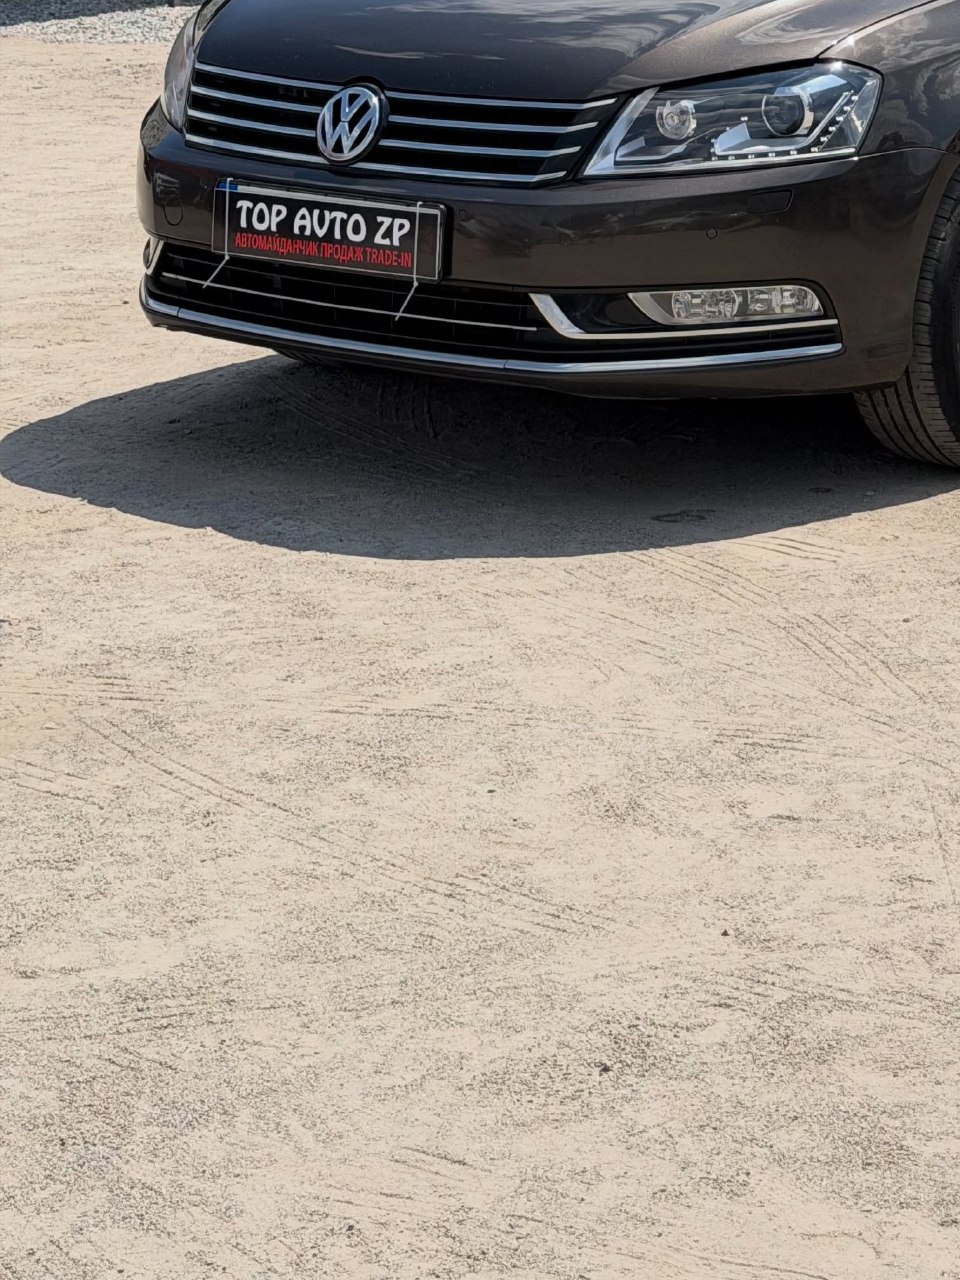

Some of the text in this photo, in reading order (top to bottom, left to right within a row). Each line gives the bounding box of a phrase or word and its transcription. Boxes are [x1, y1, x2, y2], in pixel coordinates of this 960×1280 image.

[236, 199, 411, 247] TOP AVTO ZP
[235, 231, 412, 268] АВТОМАЙДАНЧИК ПРОДАЖ TRADE-IN
